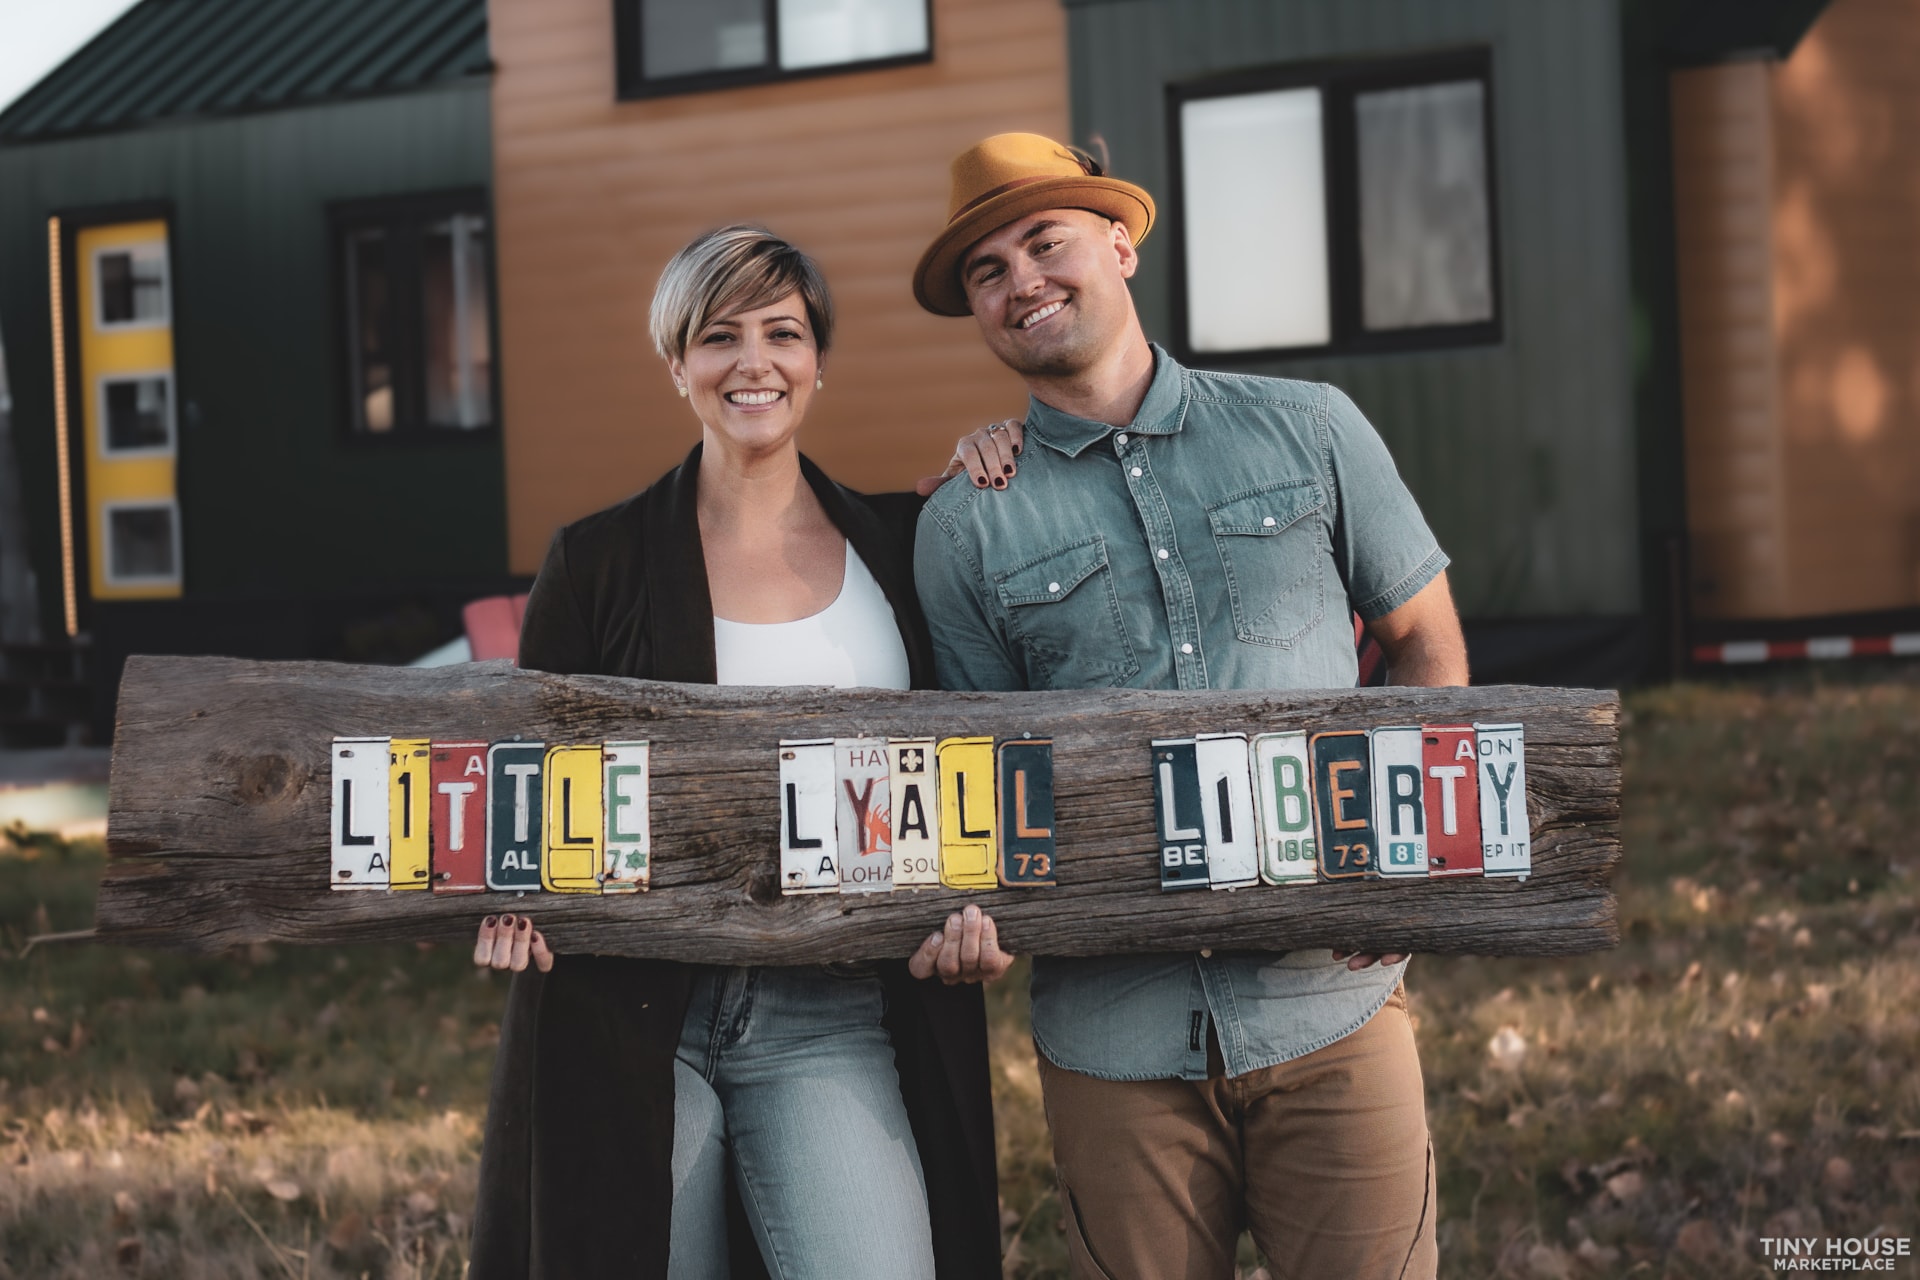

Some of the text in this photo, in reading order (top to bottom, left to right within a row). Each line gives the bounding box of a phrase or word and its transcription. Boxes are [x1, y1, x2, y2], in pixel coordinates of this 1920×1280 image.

[1455, 739, 1476, 761] A
[1479, 738, 1523, 756] ON
[463, 754, 486, 777] A
[786, 769, 1051, 854] LYALL
[500, 850, 538, 871] AL
[1333, 843, 1370, 869] 73
[1395, 844, 1409, 863] 8
[1512, 843, 1526, 857] IT
[367, 852, 387, 874] A
[818, 856, 837, 876] A
[1013, 853, 1051, 877] 73
